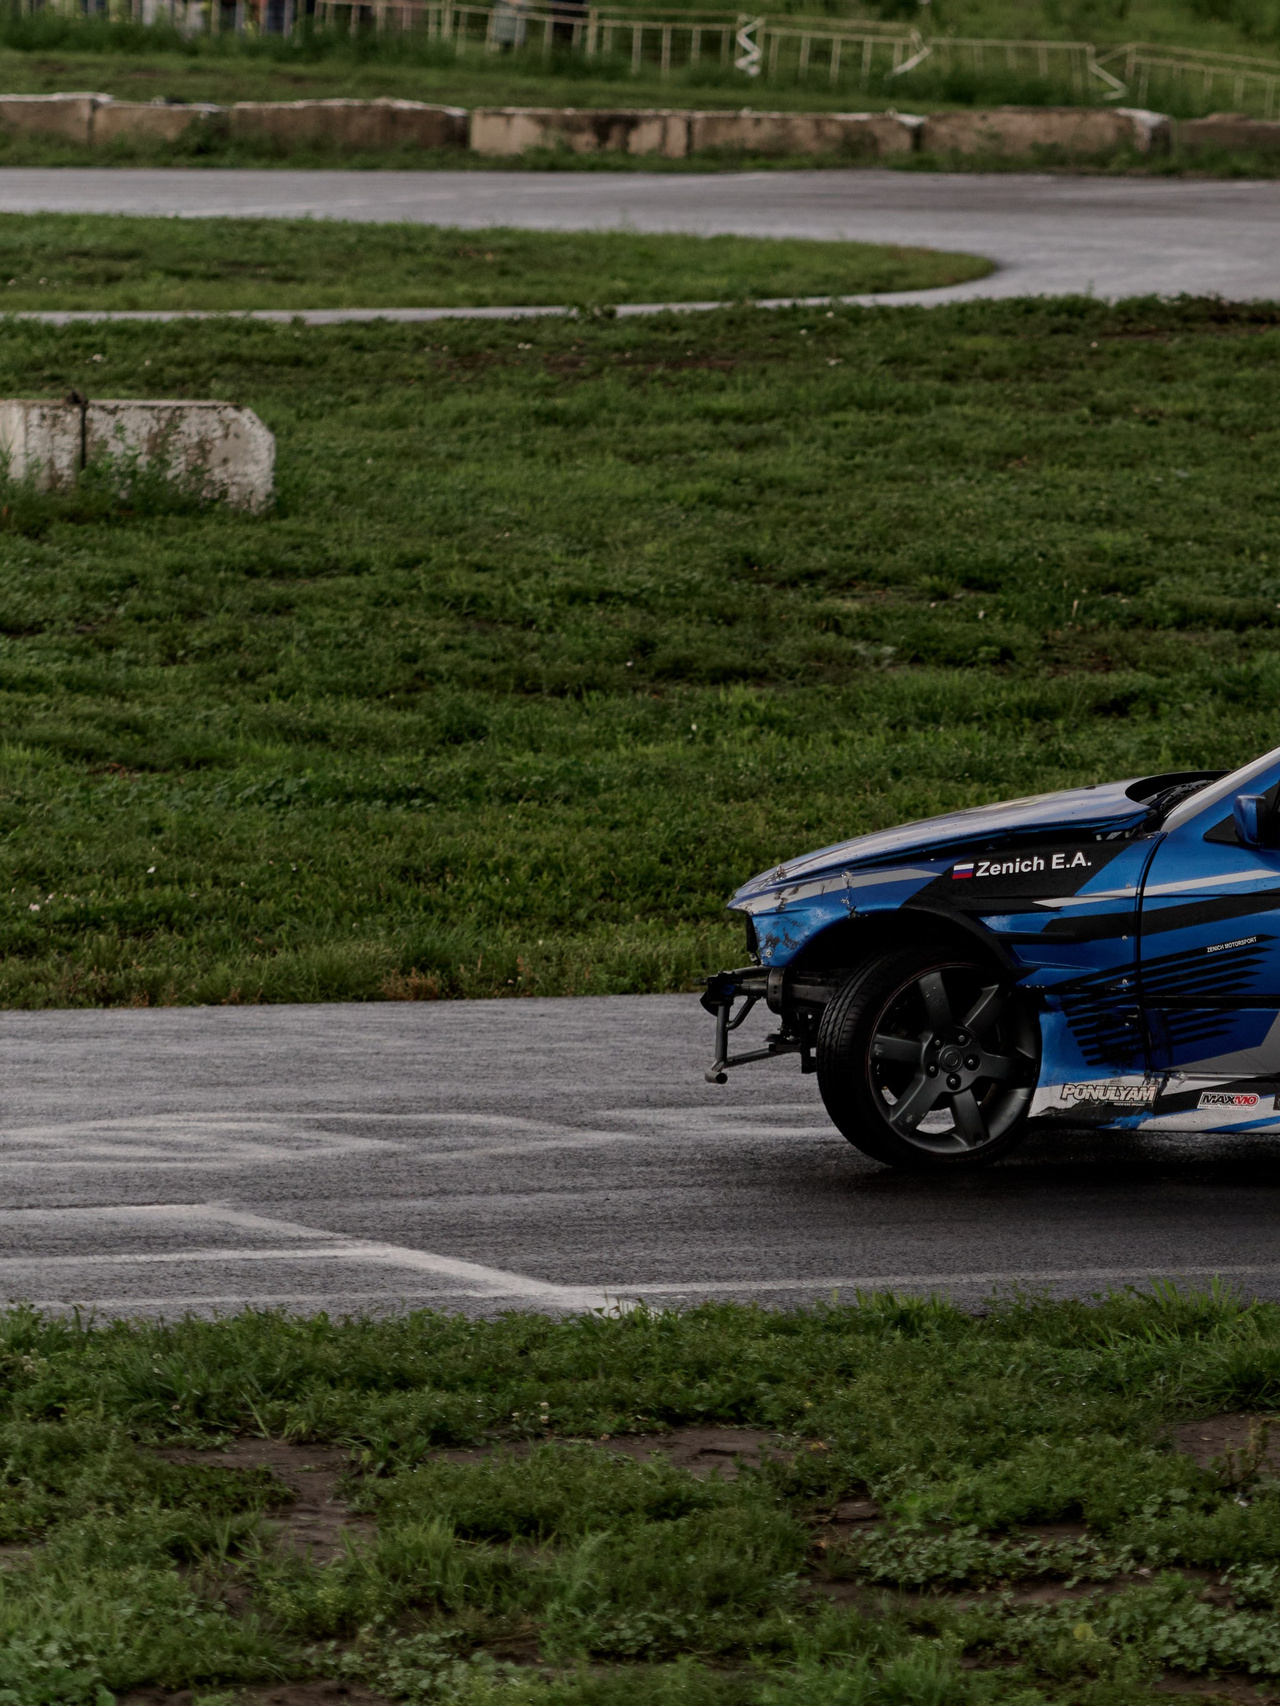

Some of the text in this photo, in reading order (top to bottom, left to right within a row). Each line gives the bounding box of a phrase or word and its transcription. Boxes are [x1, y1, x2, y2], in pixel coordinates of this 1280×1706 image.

[975, 852, 1092, 877] Zenich E.A.
[1224, 936, 1258, 949] MOTORSPORT
[1060, 1083, 1158, 1102] PONULYAM
